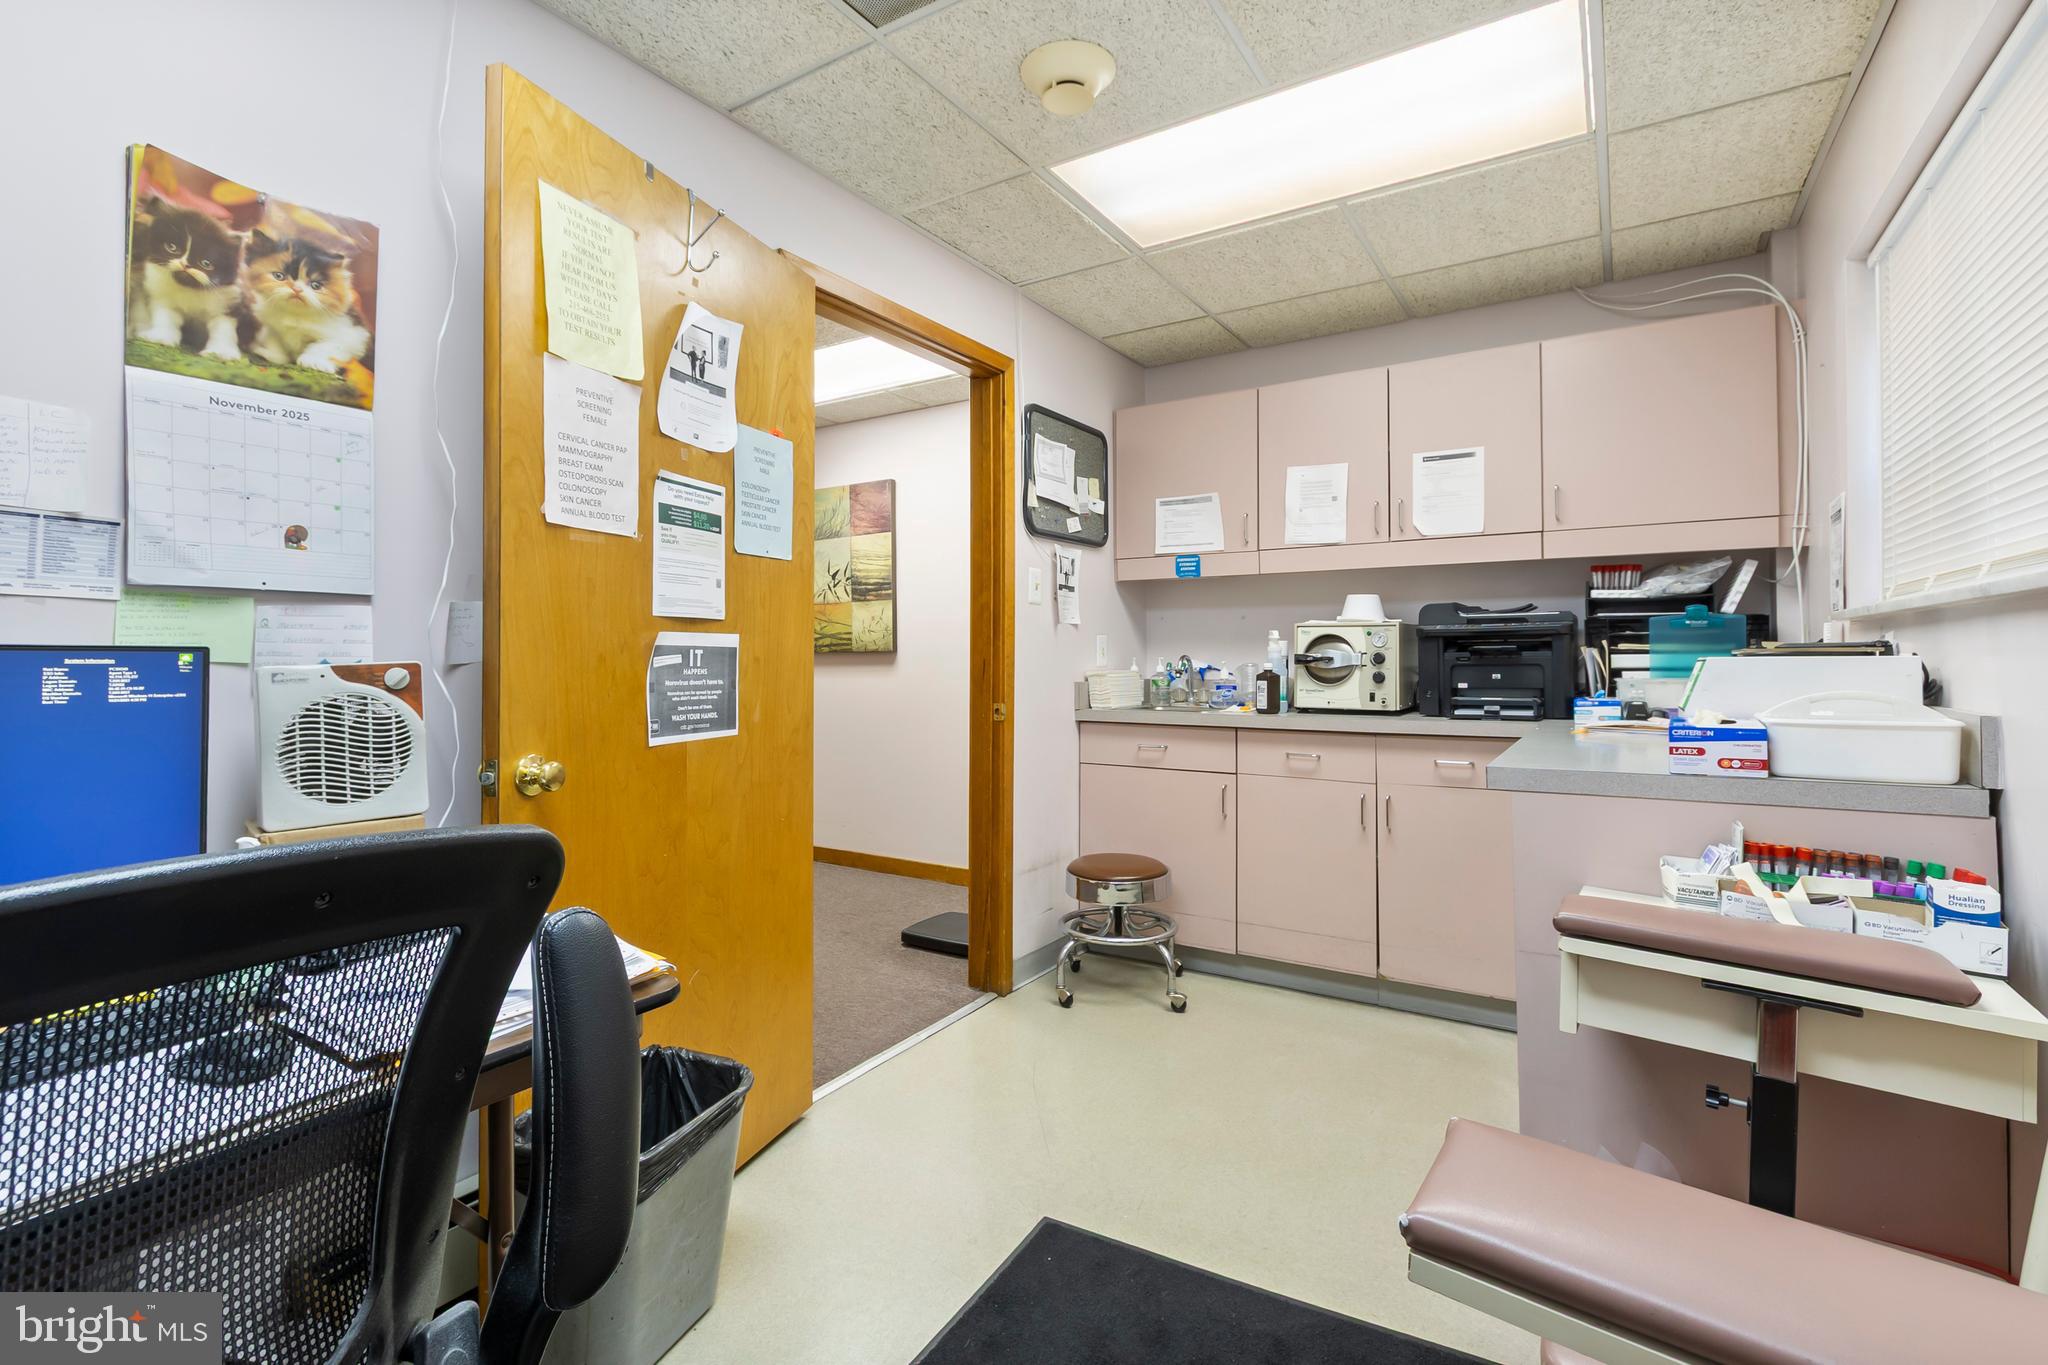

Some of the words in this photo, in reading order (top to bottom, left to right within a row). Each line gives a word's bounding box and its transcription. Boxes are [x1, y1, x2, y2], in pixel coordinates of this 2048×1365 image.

[556, 200, 584, 220] NEVER
[584, 216, 614, 236] ASSUME
[567, 217, 588, 234] YOUR
[590, 229, 608, 244] TEST
[563, 226, 597, 248] RESULTS
[597, 243, 611, 257] ARE
[571, 242, 603, 264] NORMAL
[562, 249, 568, 258] IF
[570, 253, 583, 266] YOU
[586, 260, 598, 273] DO
[599, 268, 615, 280] NOT
[561, 261, 582, 277] HEAR
[583, 270, 604, 286] FROM
[604, 280, 617, 291] US
[564, 286, 591, 305] PLEASE
[593, 299, 613, 313] CALL
[596, 287, 618, 303] DAYS
[559, 306, 570, 319] TO
[570, 311, 599, 329] OBTAIN
[600, 322, 622, 337] YOUR
[564, 321, 583, 337] TEST
[584, 328, 616, 346] RESULTS
[575, 386, 614, 405] PREVENTIVE
[208, 395, 278, 418] November
[281, 408, 311, 422] 2025
[577, 399, 612, 416] SCREENING
[582, 413, 608, 427] FEMALE
[557, 432, 589, 447] CERVICAL
[590, 439, 615, 452] CANCER
[615, 445, 628, 454] PAP
[558, 444, 613, 463] MAMMOGRAPHY
[558, 456, 583, 469] BREAST
[584, 463, 604, 473] EXAM
[558, 469, 608, 486] OSTEOPOROSIS
[608, 478, 624, 488] SCAN
[741, 480, 770, 493] COLONOSCOPY
[558, 481, 607, 497] COLONOSCOPY
[741, 490, 764, 501] TESTICULAR
[765, 496, 780, 505] CANCER
[559, 494, 574, 504] SKIN
[575, 497, 602, 508] CANCER
[741, 500, 761, 510] PROSTATE
[762, 506, 776, 514] CANCER
[560, 506, 587, 518] ANNUAL
[588, 510, 611, 521] BLOOD
[611, 513, 626, 523] TEST
[752, 512, 767, 520] CANCER
[741, 519, 758, 528] ANNUAL
[759, 523, 771, 531] BLOOD
[689, 649, 704, 667] IT
[683, 668, 708, 676] HAPPENS
[1671, 729, 1714, 737] CRITERION
[1677, 886, 1715, 897] VACUTAINER
[1948, 893, 1986, 905] Hualian
[1948, 900, 1986, 912] Dressing
[1883, 924, 1920, 934] Vacutainer
